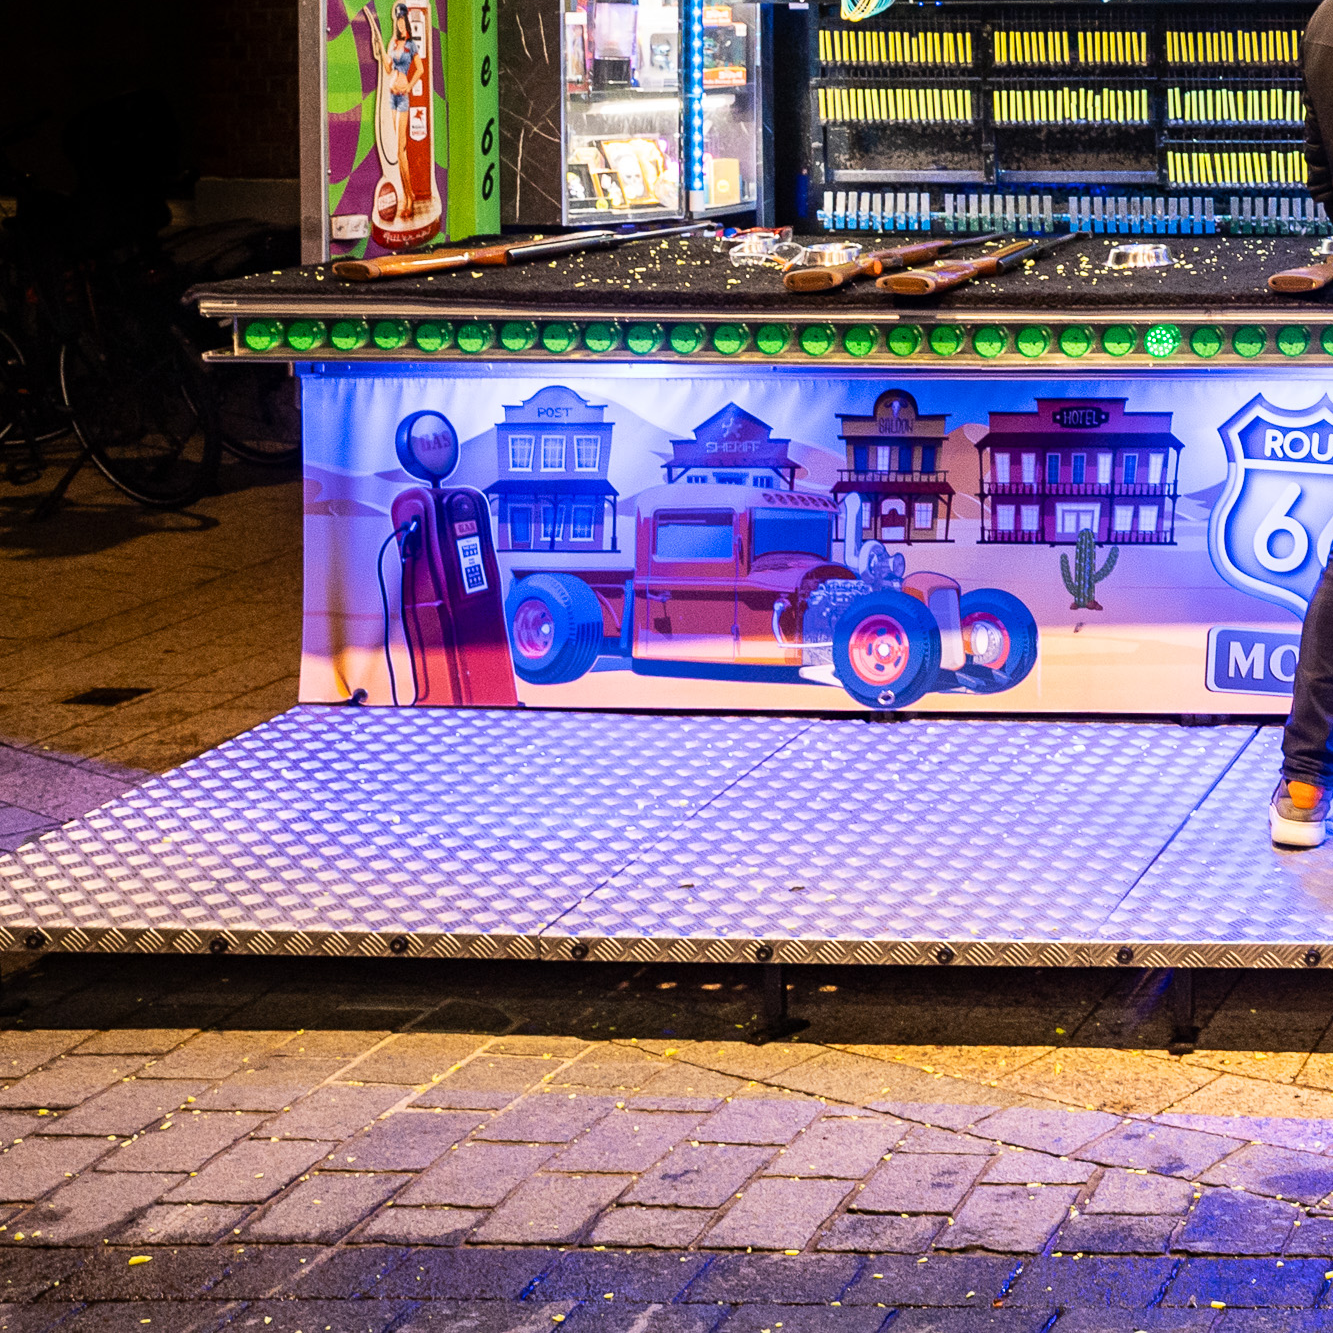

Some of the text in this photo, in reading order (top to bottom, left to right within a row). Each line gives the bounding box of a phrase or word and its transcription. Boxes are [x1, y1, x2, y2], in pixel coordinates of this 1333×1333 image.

[537, 407, 573, 419] POST
[1062, 409, 1099, 425] HOTEL
[878, 416, 914, 434] SALOON
[706, 440, 761, 454] SHERIFF
